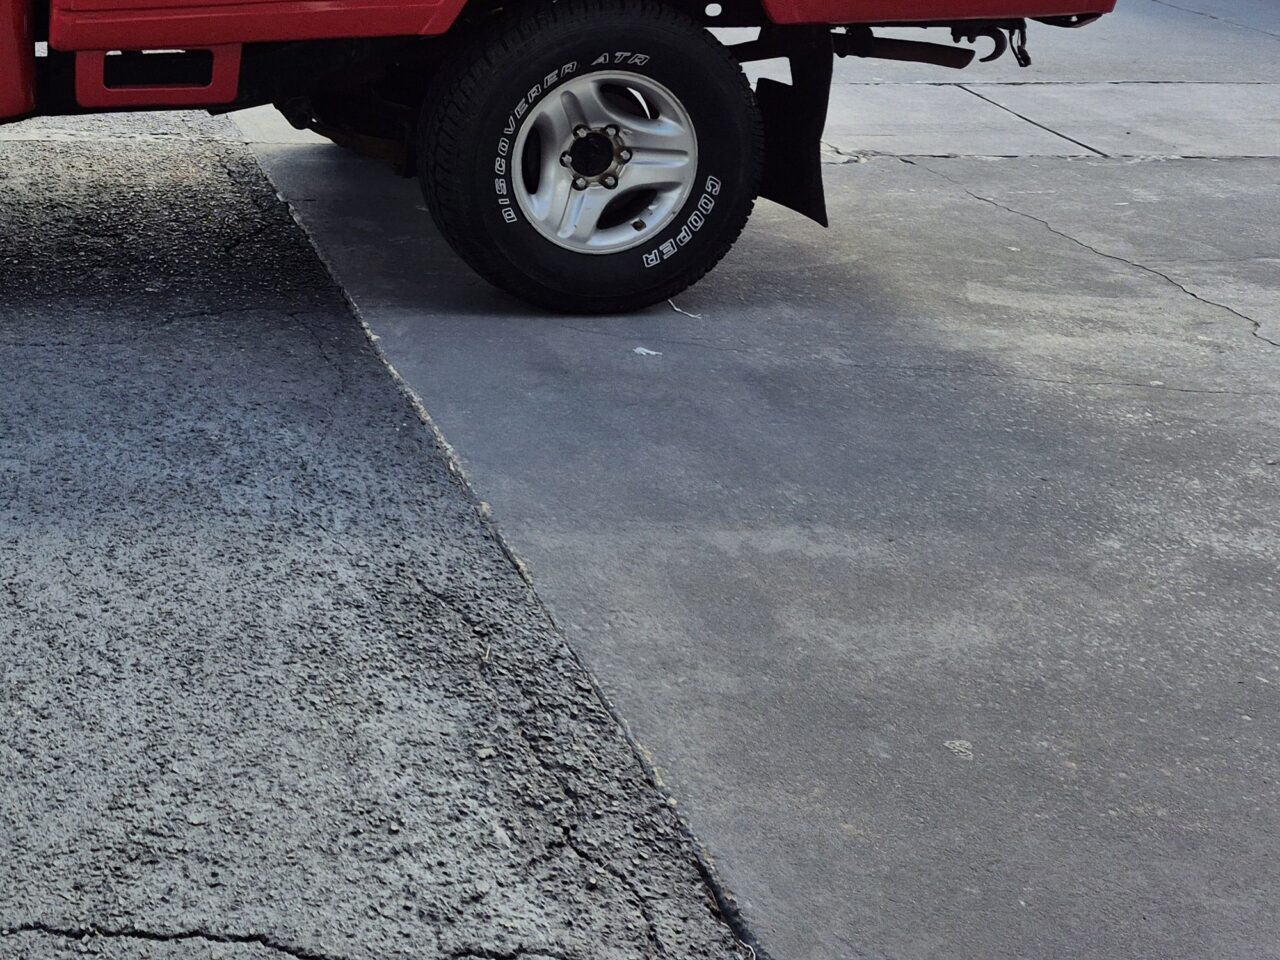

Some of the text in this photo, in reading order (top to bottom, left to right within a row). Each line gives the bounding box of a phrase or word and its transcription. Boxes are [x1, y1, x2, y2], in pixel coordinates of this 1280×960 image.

[494, 51, 650, 224] DISCOVERER ATR
[642, 175, 721, 268] COOPER
